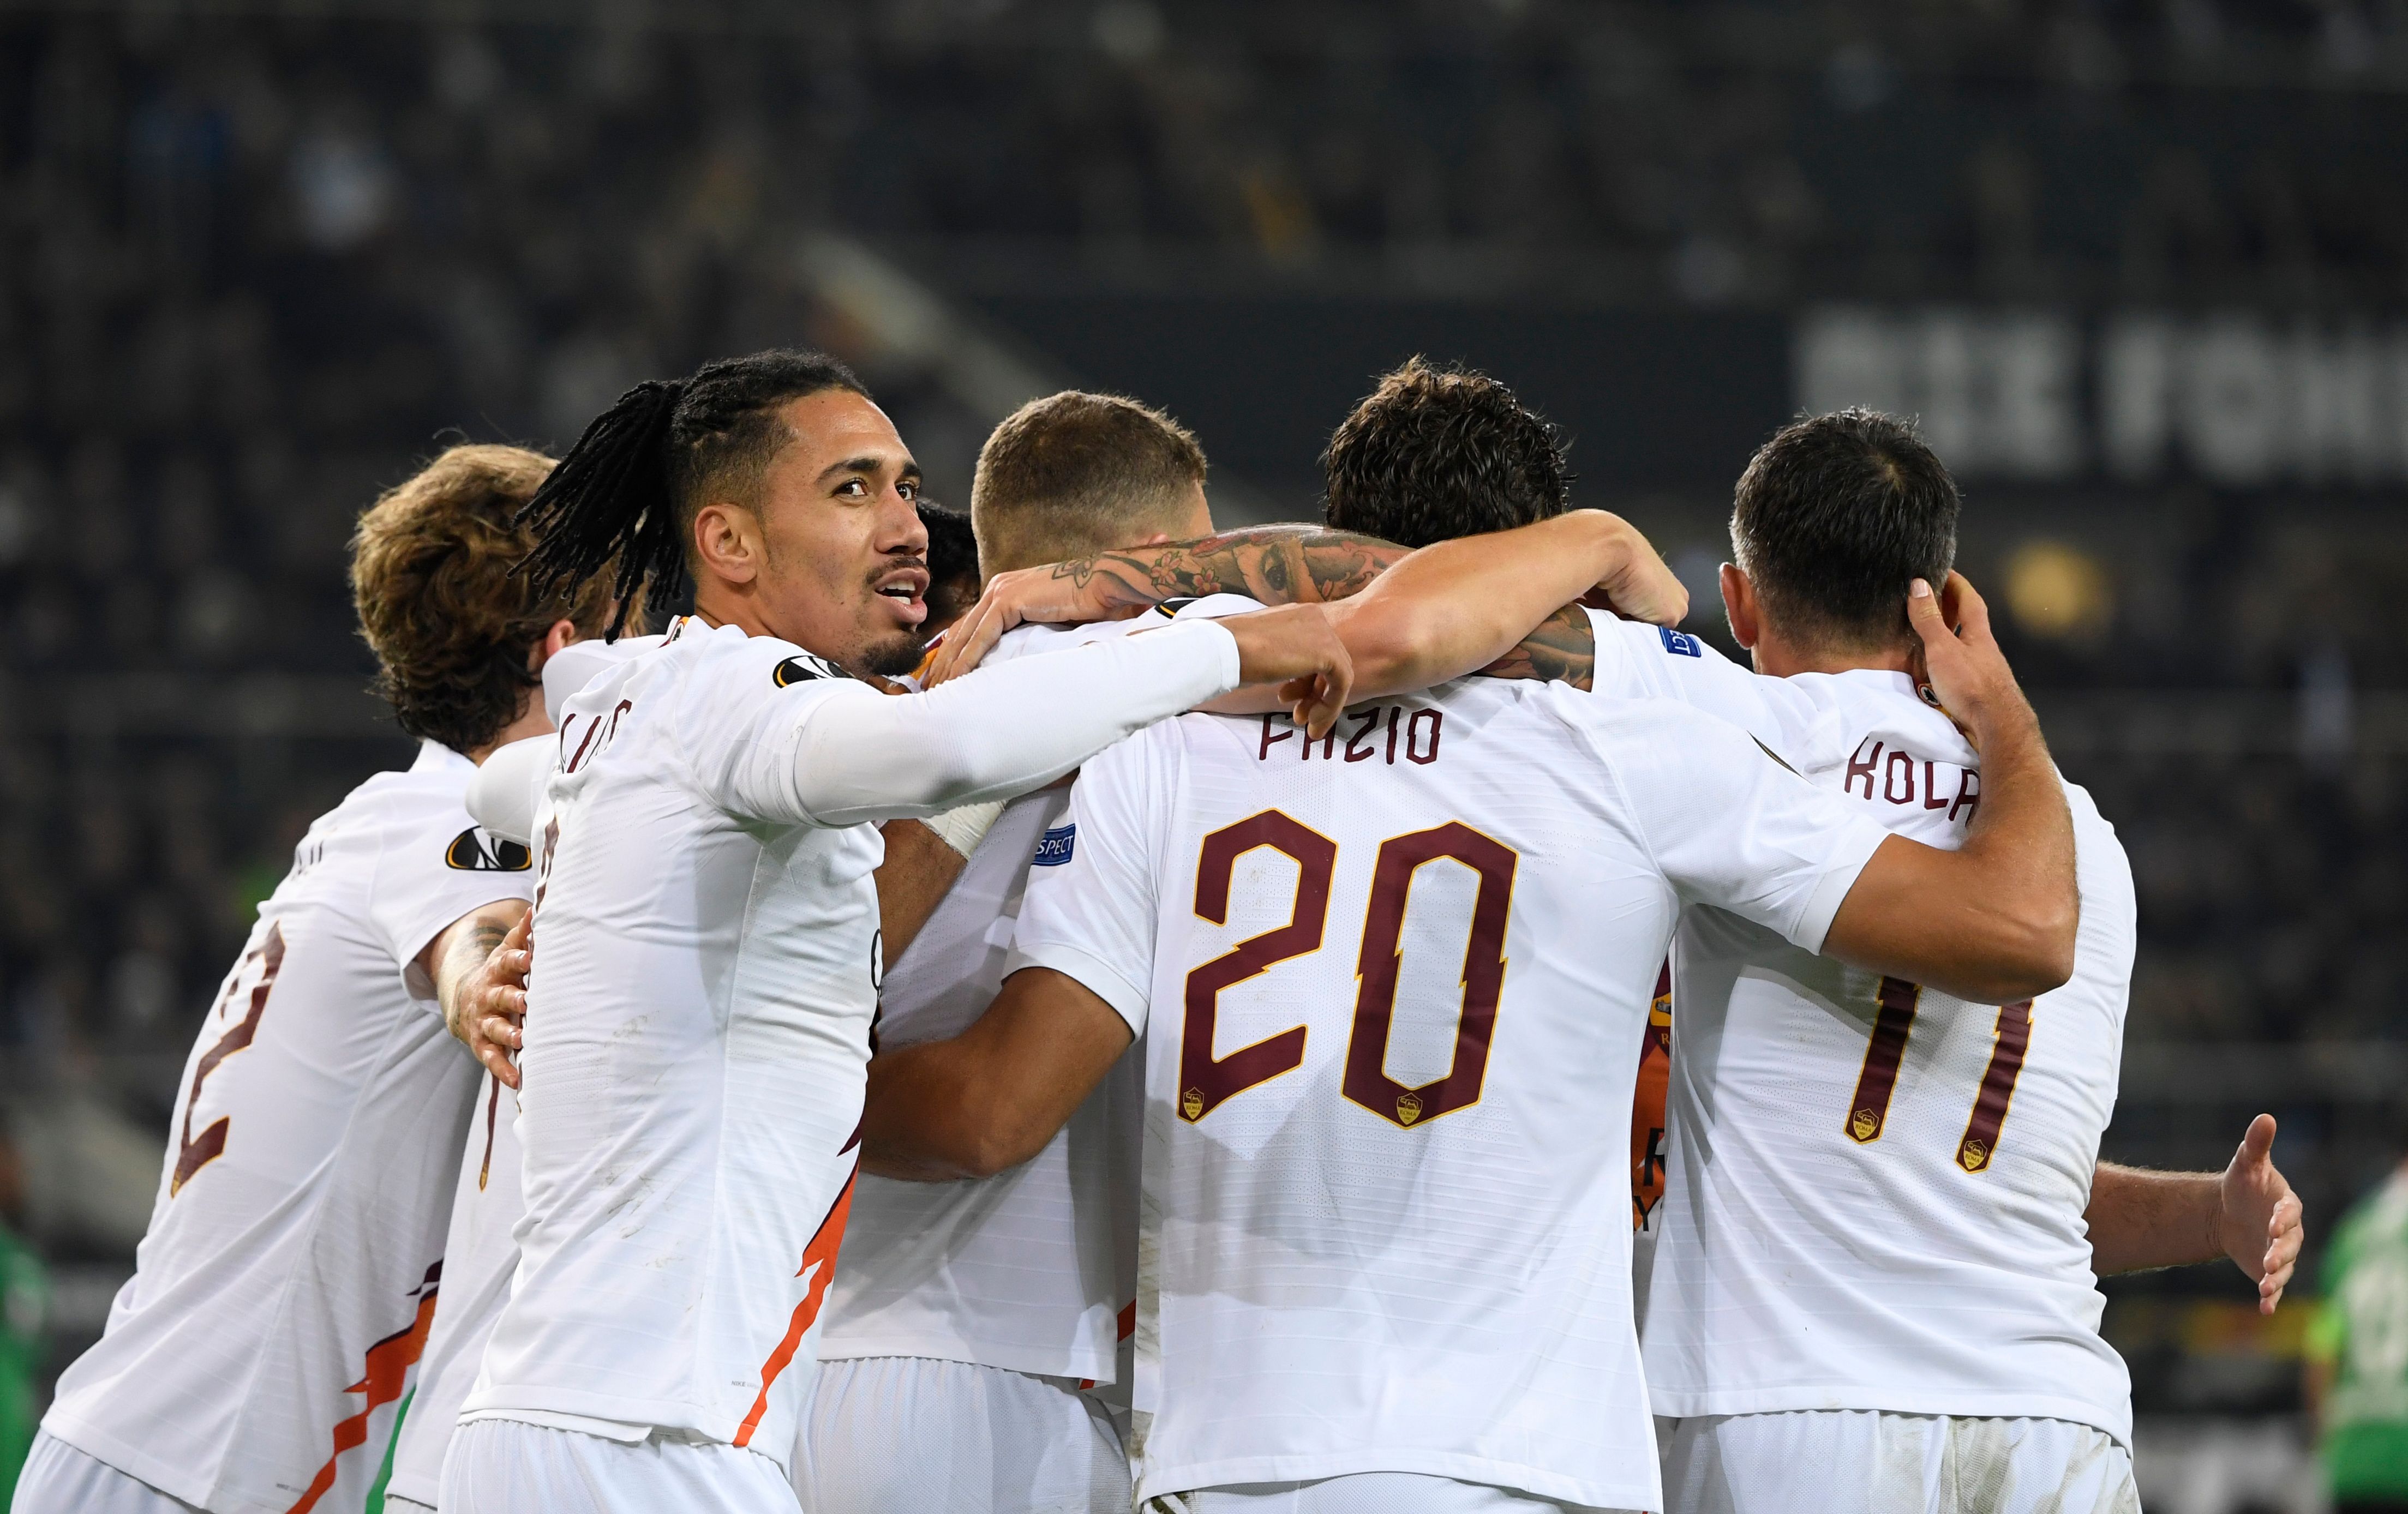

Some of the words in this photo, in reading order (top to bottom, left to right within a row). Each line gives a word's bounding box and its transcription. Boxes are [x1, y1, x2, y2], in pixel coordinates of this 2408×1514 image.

[1669, 630, 1691, 654] ECT
[1259, 706, 1443, 765] FAZIO
[1844, 736, 1981, 827] KOLA
[1035, 835, 1074, 855] SPECT
[1176, 808, 1519, 1130] 20
